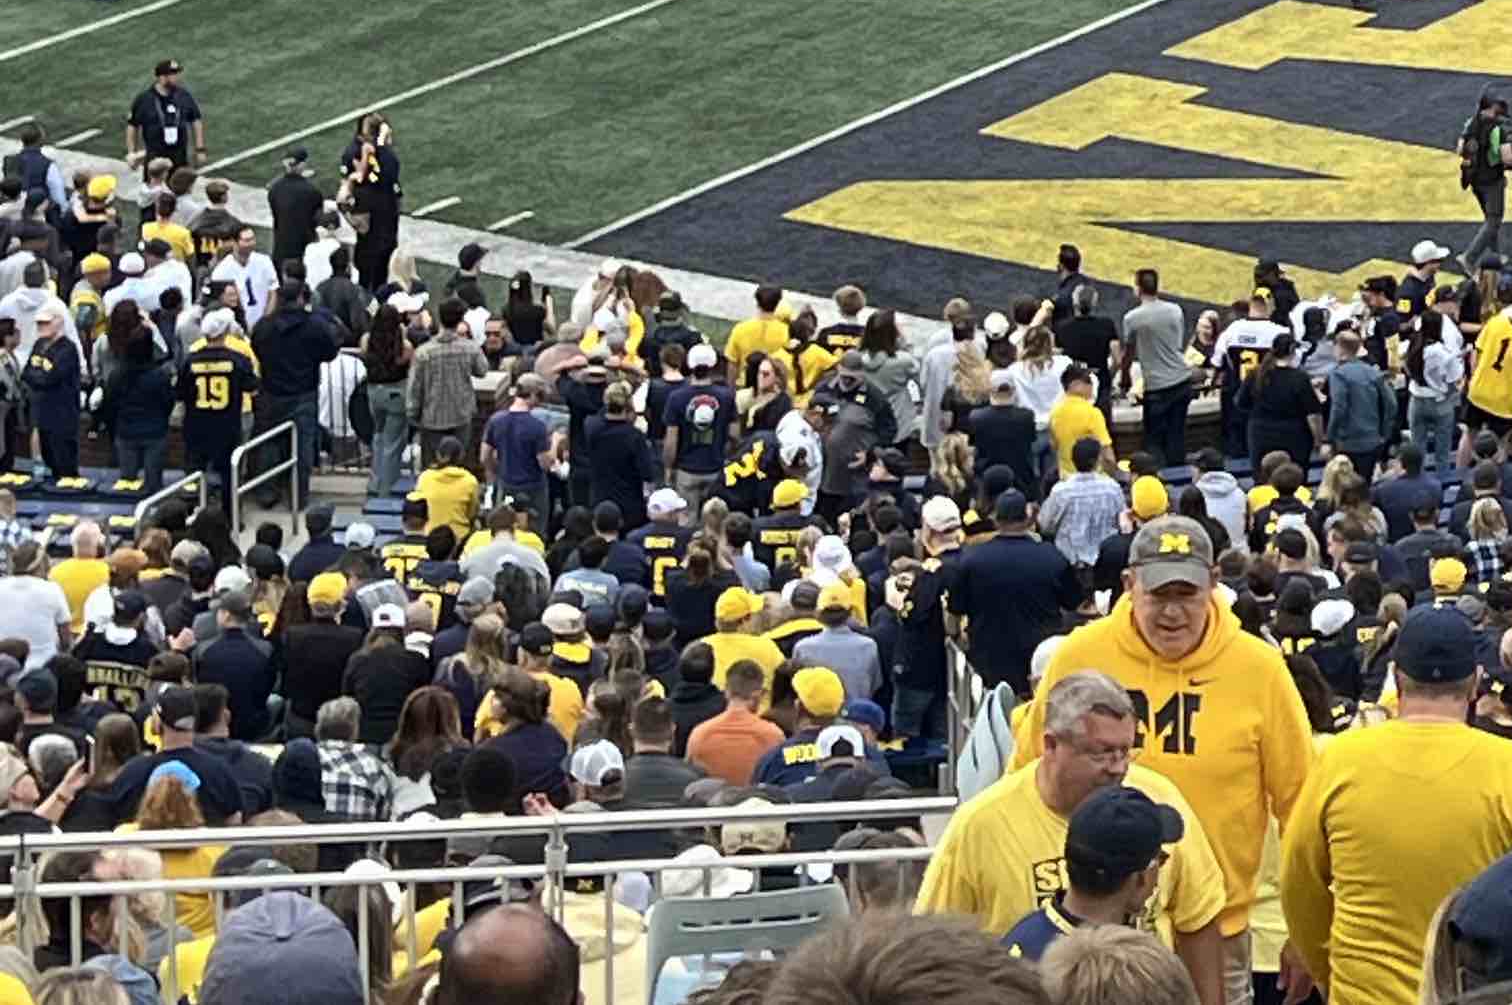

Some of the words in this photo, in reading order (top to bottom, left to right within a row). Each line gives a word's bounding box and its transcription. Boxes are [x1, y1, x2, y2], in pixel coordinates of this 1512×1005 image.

[246, 277, 258, 306] 1
[1492, 337, 1512, 373] 1
[196, 375, 230, 411] 19
[1159, 533, 1191, 553] M
[1126, 689, 1204, 755] M
